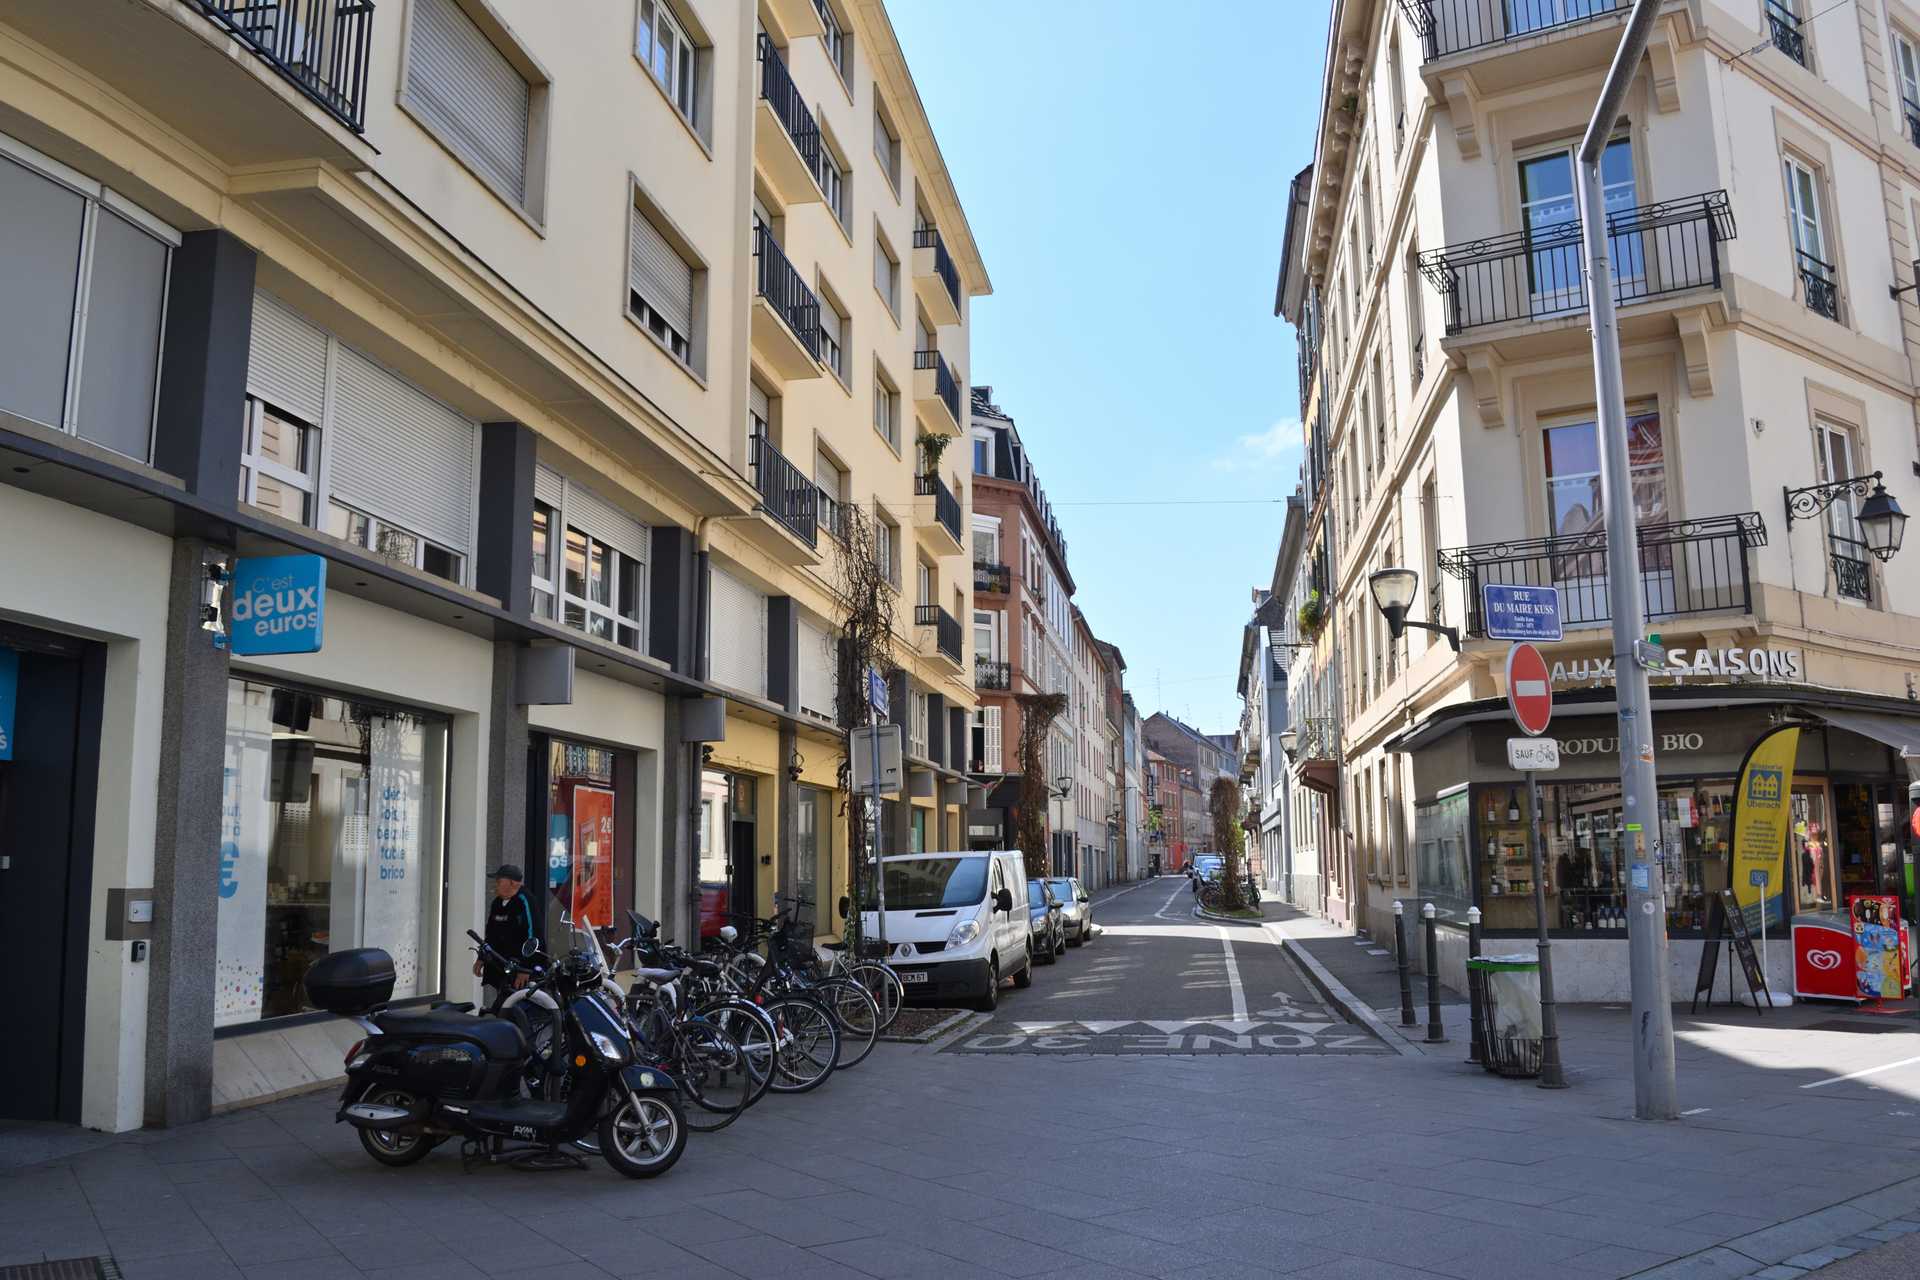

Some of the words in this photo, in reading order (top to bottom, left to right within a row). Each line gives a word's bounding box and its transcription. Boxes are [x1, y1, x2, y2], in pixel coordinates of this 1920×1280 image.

[232, 586, 317, 621] deux
[1513, 591, 1530, 602] RUE
[1493, 603, 1505, 613] DU
[1506, 603, 1533, 614] MAIRE
[254, 611, 318, 637] euros
[1550, 657, 1612, 682] AUX
[1667, 648, 1799, 678] SAISONS
[1661, 733, 1704, 751] BIO
[1514, 749, 1535, 760] SAUF
[380, 865, 405, 880] brico
[963, 1034, 1091, 1050] 30
[1124, 1034, 1374, 1050] ZONE
